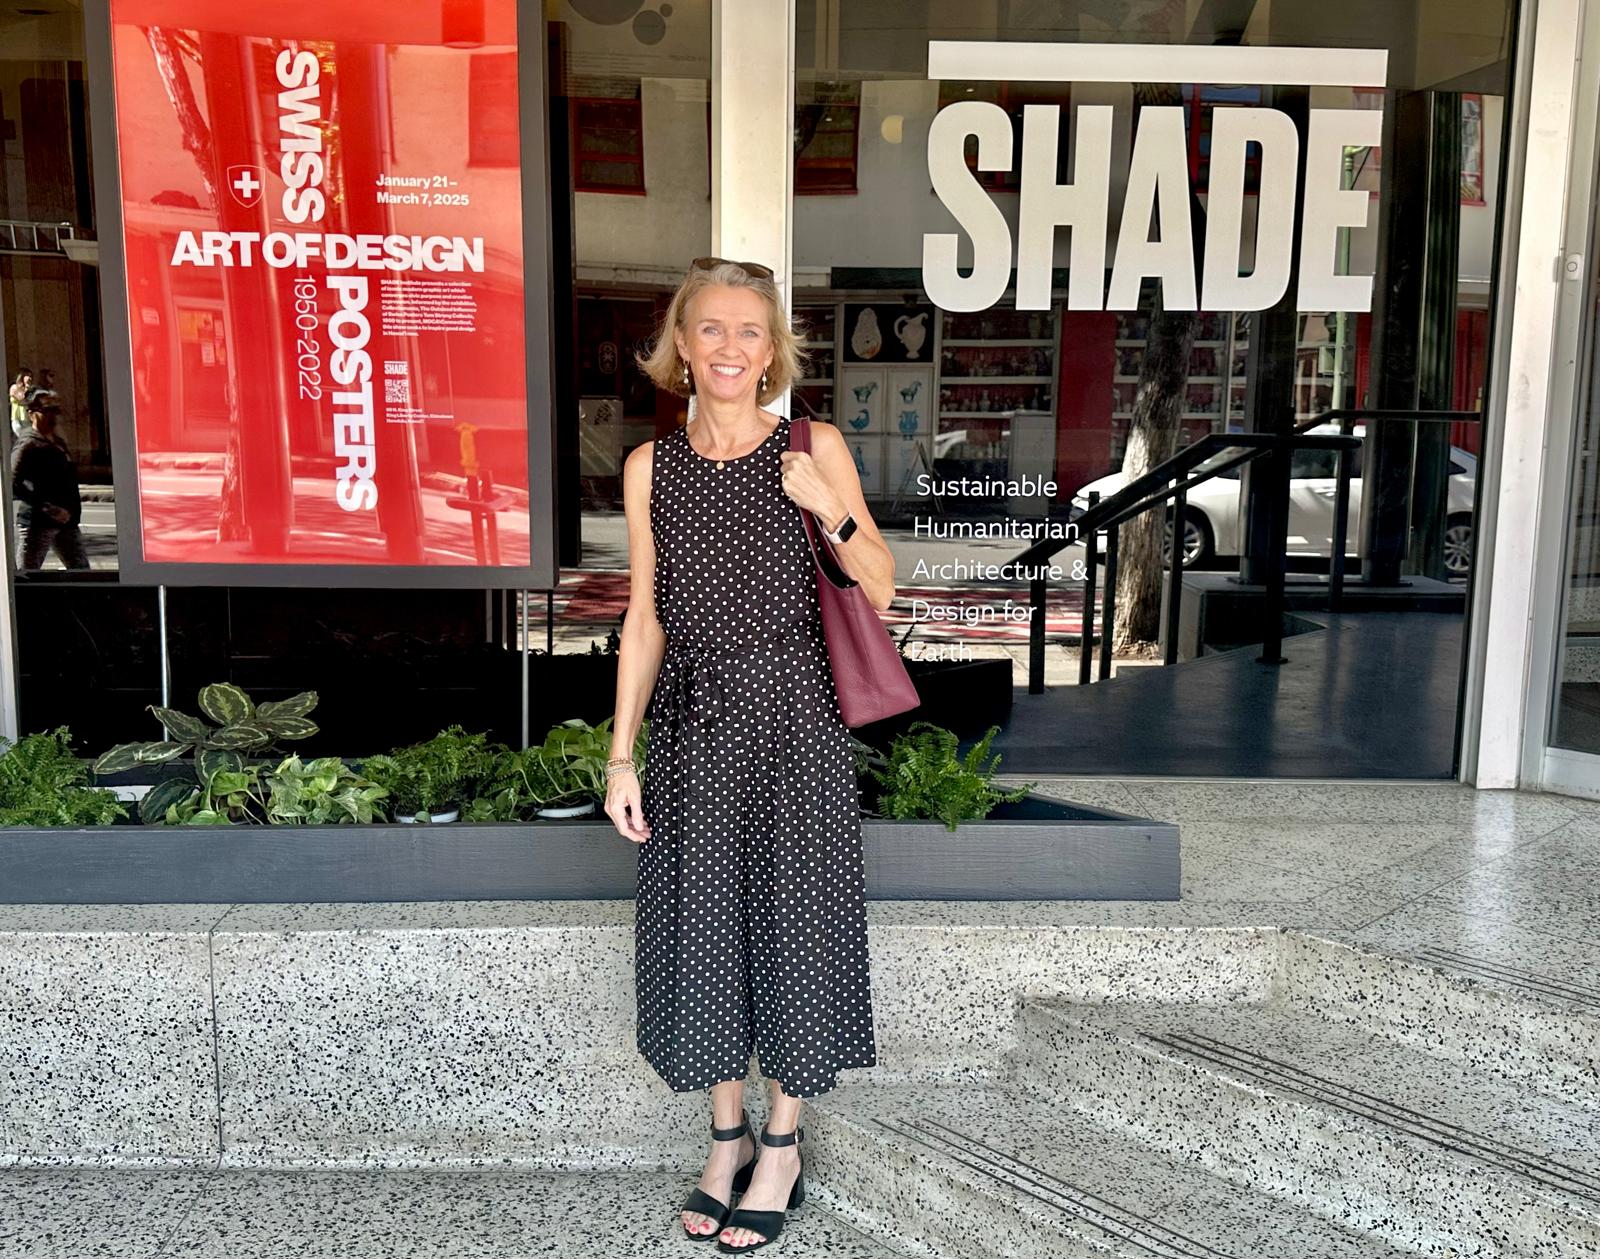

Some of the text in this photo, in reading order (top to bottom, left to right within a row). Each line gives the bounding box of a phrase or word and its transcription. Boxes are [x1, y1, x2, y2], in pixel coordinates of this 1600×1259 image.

[275, 49, 326, 224] SWISS
[376, 174, 431, 188] January
[376, 192, 469, 207] March 7, 2025
[922, 101, 1384, 312] SHADE
[171, 231, 485, 272] ART OF DESIGN
[384, 364, 408, 374] SHADE
[326, 275, 378, 512] POSTERS
[916, 474, 1058, 498] Sustainable
[914, 517, 1079, 539] Humanitarian
[912, 559, 1089, 581] Architecture &
[912, 600, 1037, 626] Design for
[911, 641, 973, 662] Earth
